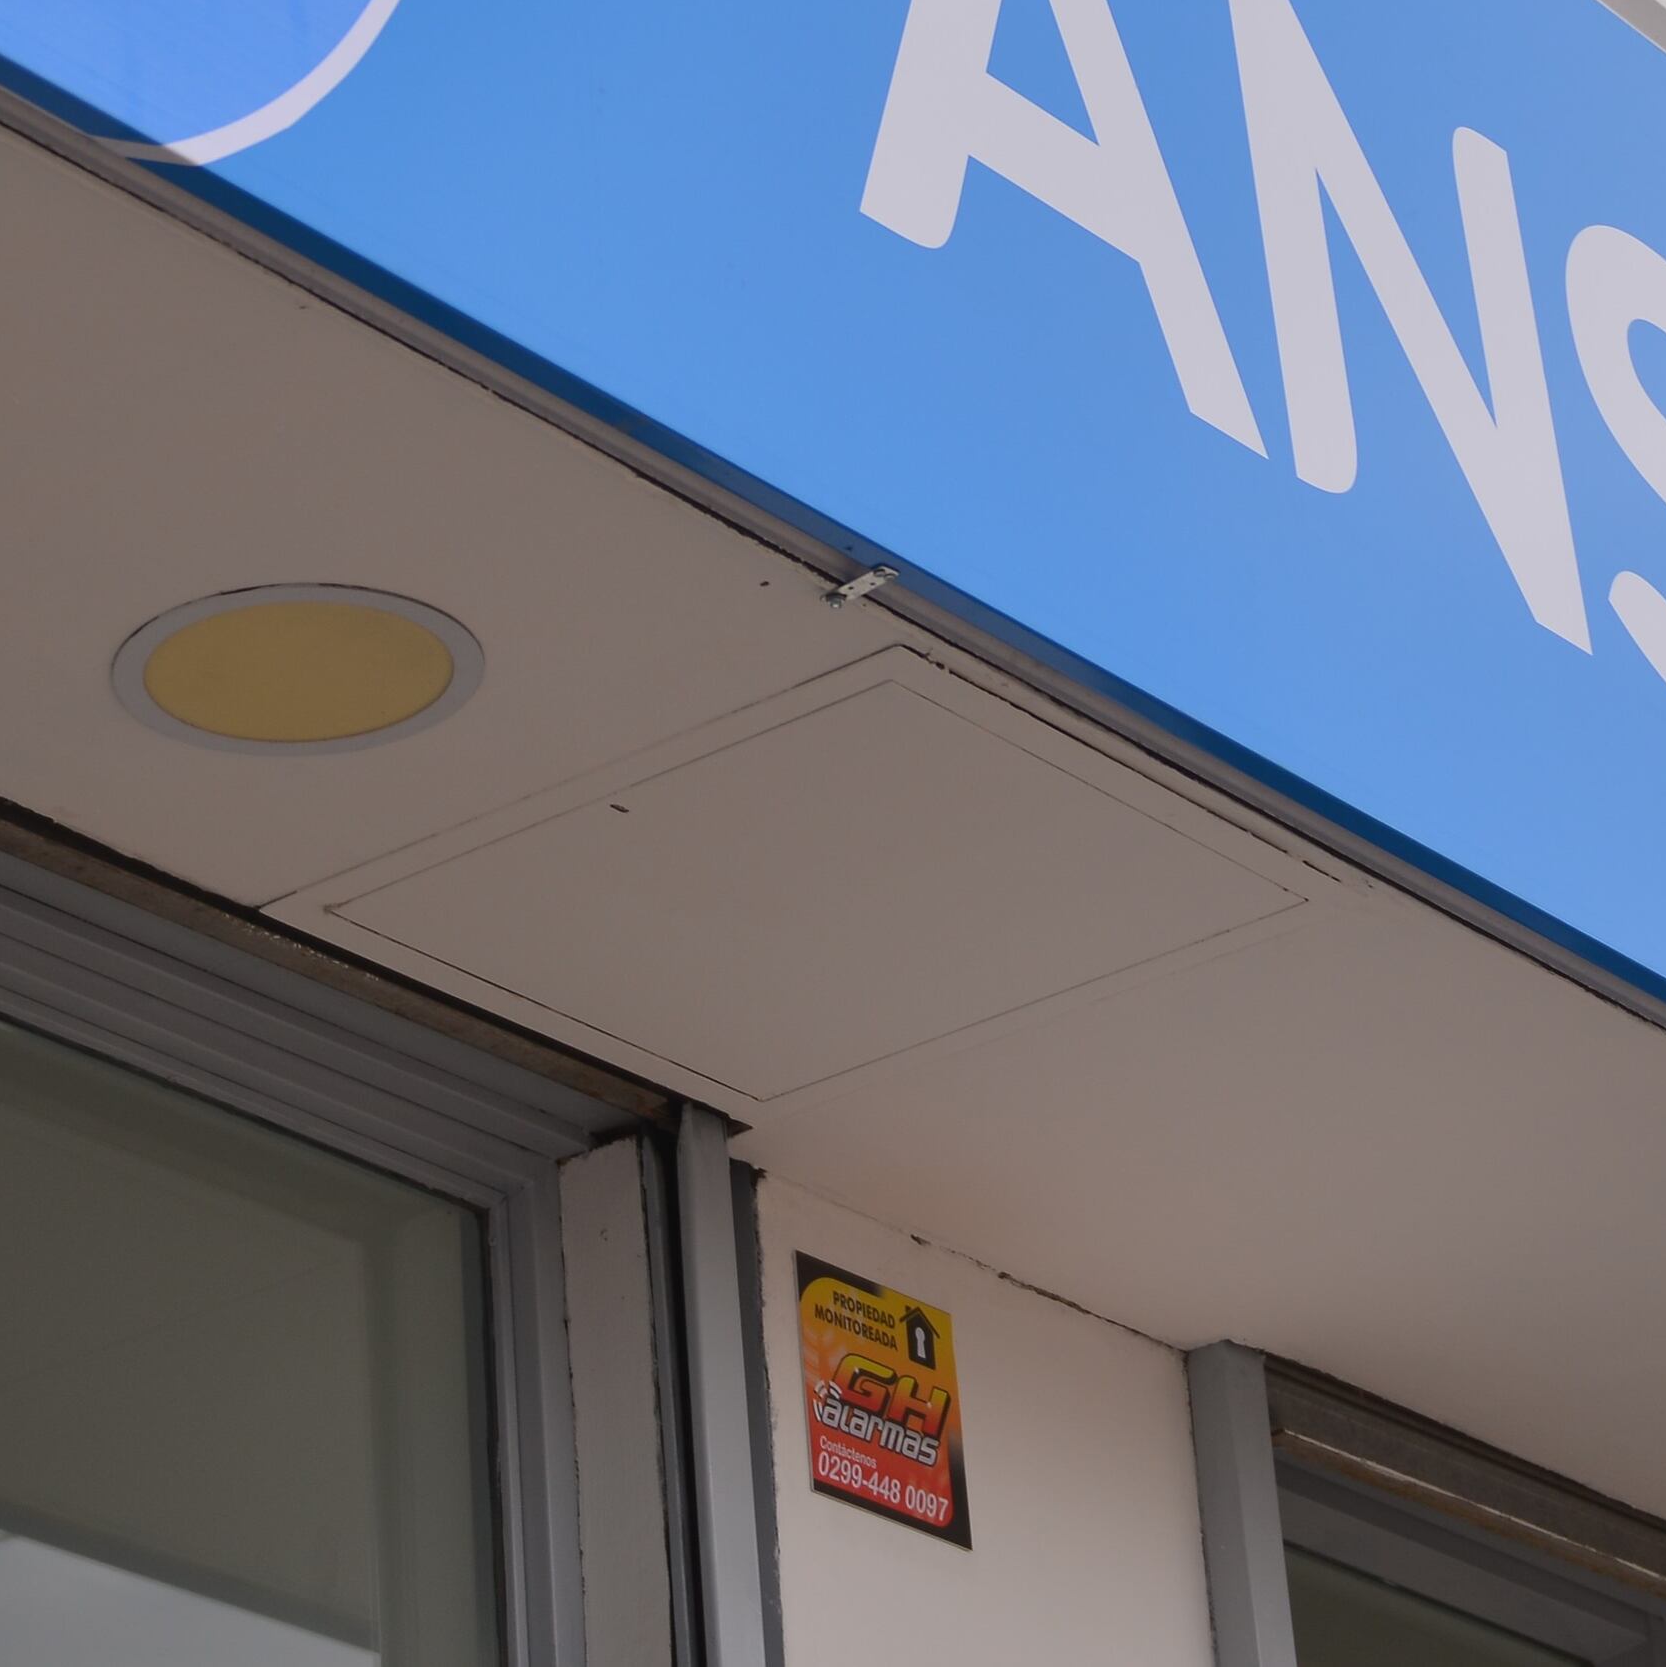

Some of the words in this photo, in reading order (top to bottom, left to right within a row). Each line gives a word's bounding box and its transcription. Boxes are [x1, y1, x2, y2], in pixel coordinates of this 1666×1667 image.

[814, 1304, 898, 1352] MONITOREADA
[833, 1291, 895, 1329] PROPIEDAD
[833, 1353, 950, 1438] GH
[819, 1436, 877, 1469] Contáctenos
[818, 1451, 901, 1504] 0299-448
[905, 1485, 949, 1522] 0097
